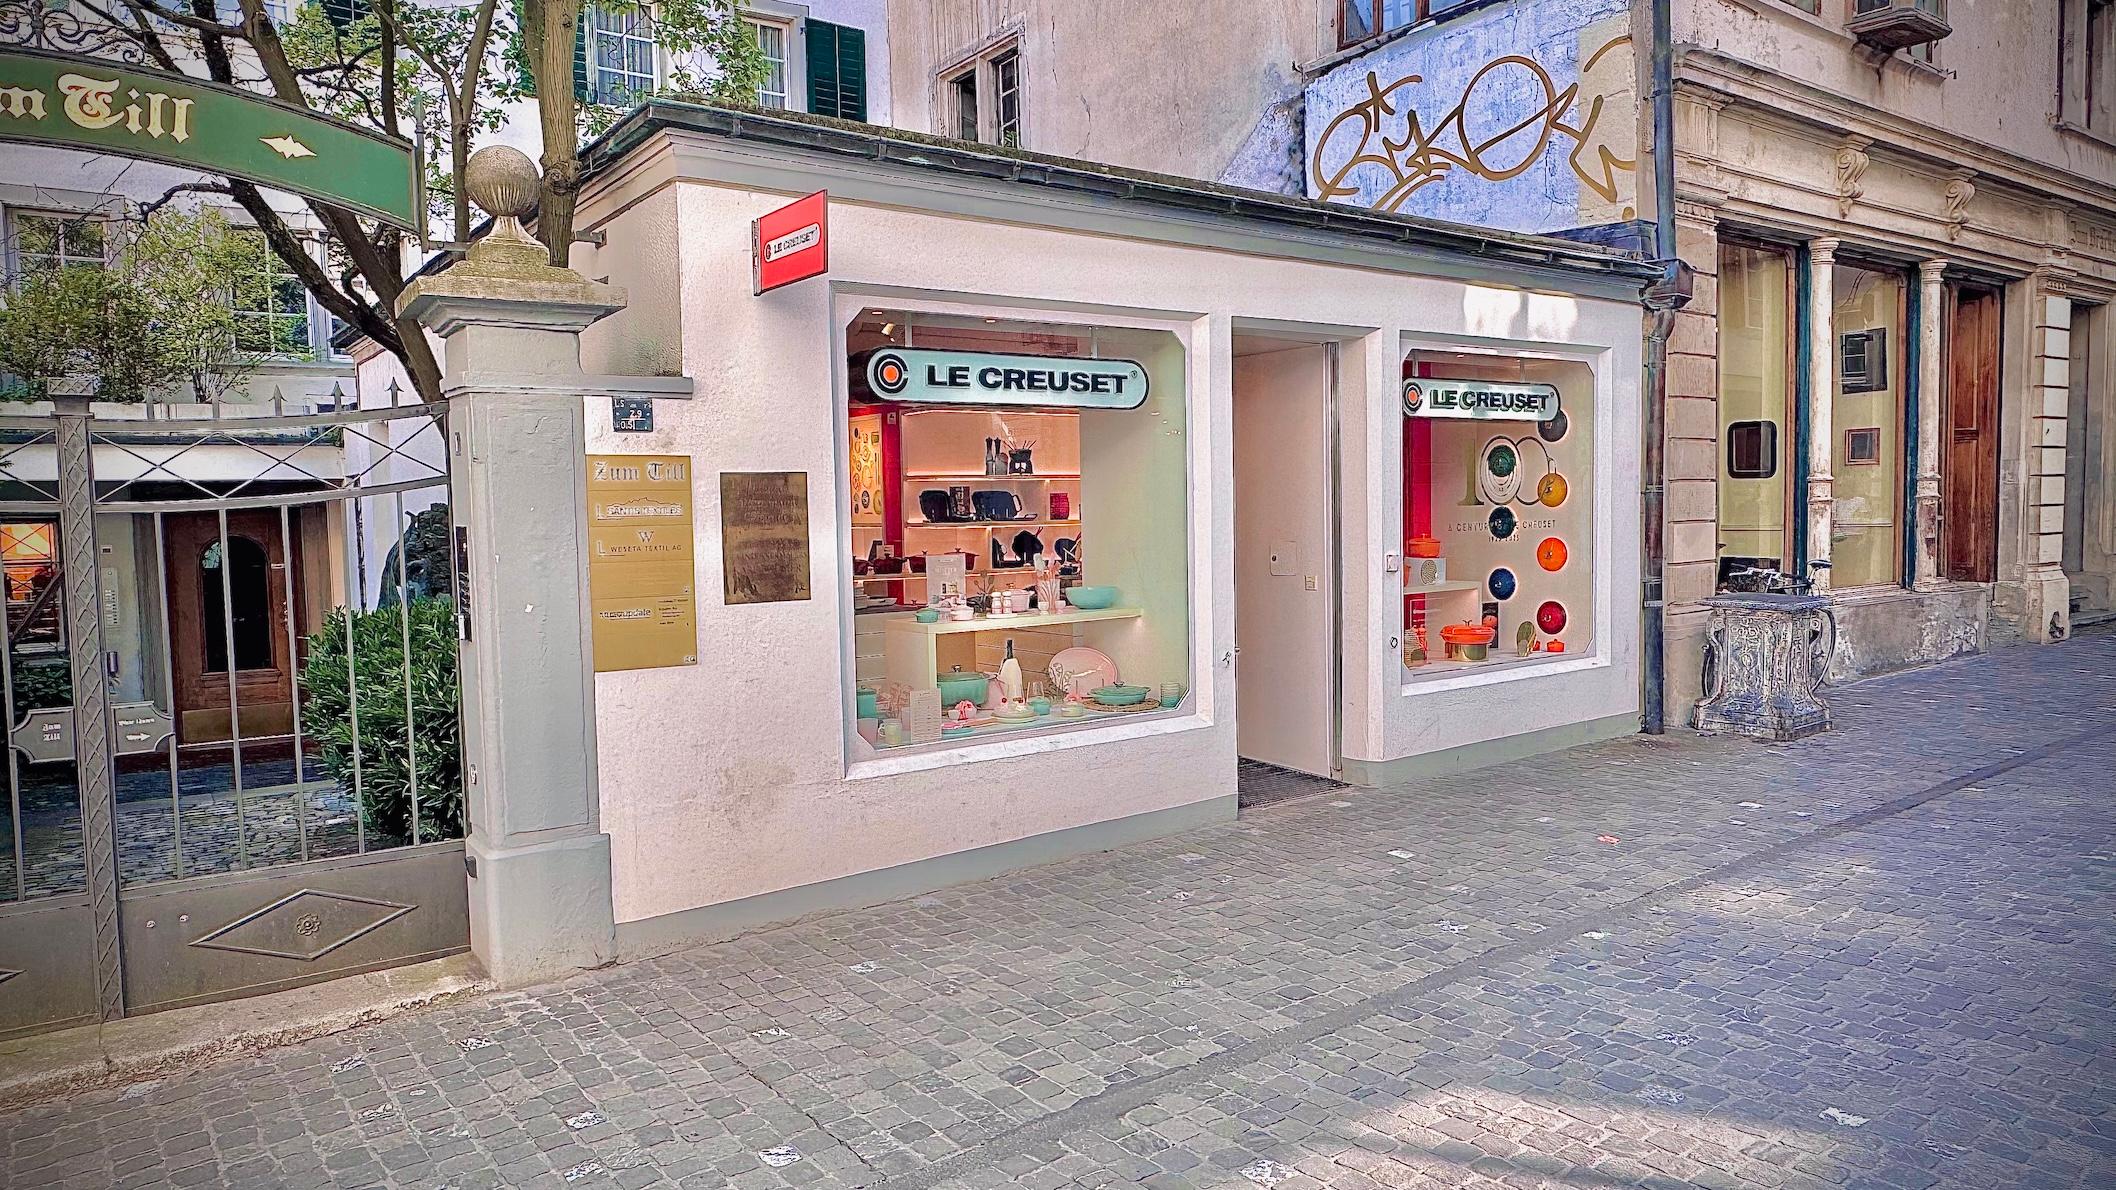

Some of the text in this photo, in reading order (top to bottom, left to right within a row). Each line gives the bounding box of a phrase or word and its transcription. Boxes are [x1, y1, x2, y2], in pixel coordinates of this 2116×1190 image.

[57, 73, 196, 144] Till
[773, 228, 815, 254] LE CREUSET
[926, 364, 1128, 395] LE CREUSET
[1431, 389, 1549, 411] LE CREUSET
[594, 461, 685, 481] Zum Till
[639, 530, 654, 543] W
[1456, 522, 1489, 532] CENTUR
[610, 545, 642, 553] WESETA
